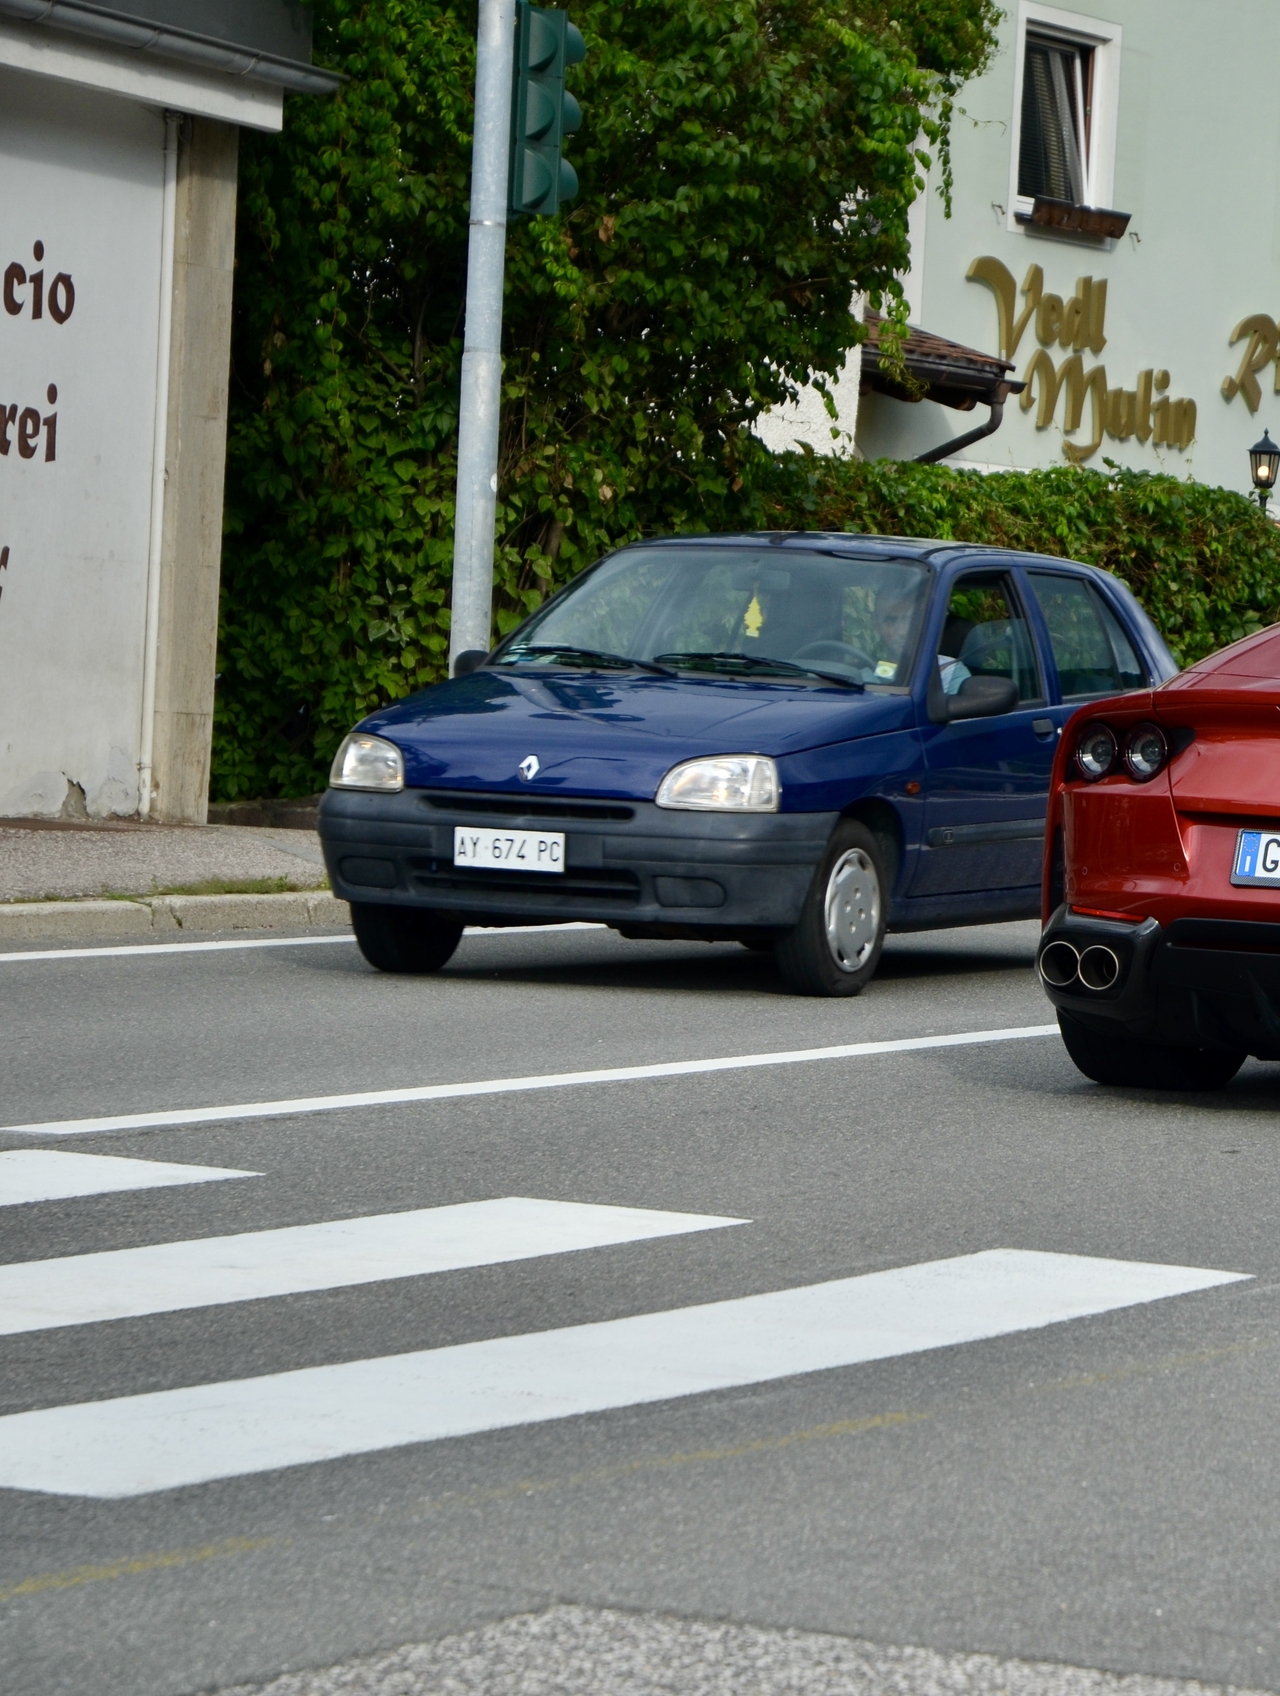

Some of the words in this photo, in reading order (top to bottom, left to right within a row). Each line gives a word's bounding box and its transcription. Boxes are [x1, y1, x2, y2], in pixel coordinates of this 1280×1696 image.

[966, 256, 1108, 358] Vedl
[1019, 348, 1198, 460] Mulin
[458, 836, 480, 858] AY
[492, 838, 527, 860] 674
[537, 840, 560, 862] PC
